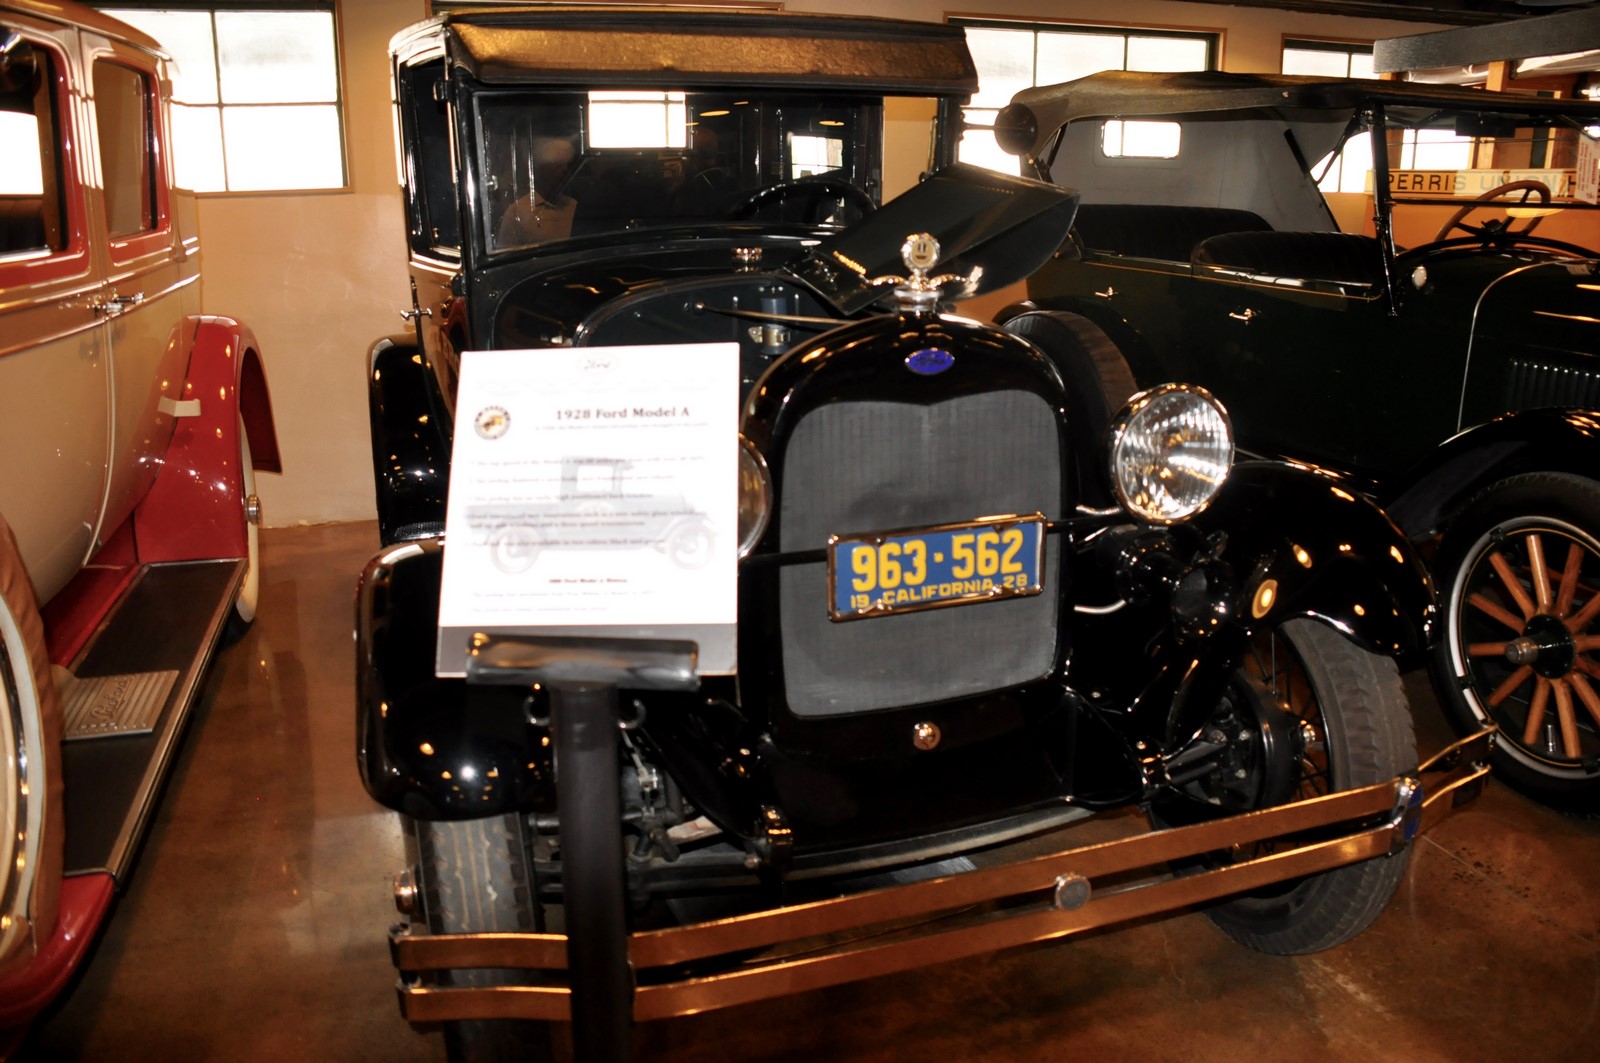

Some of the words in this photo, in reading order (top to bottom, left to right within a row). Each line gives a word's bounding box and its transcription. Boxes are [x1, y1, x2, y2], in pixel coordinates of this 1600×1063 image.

[557, 409, 591, 420] 1928
[596, 408, 627, 419] Ford
[633, 406, 676, 418] Model
[681, 407, 690, 417] A
[851, 594, 870, 608] 19
[882, 577, 994, 605] CALIFORNIA
[1002, 573, 1028, 588] 28
